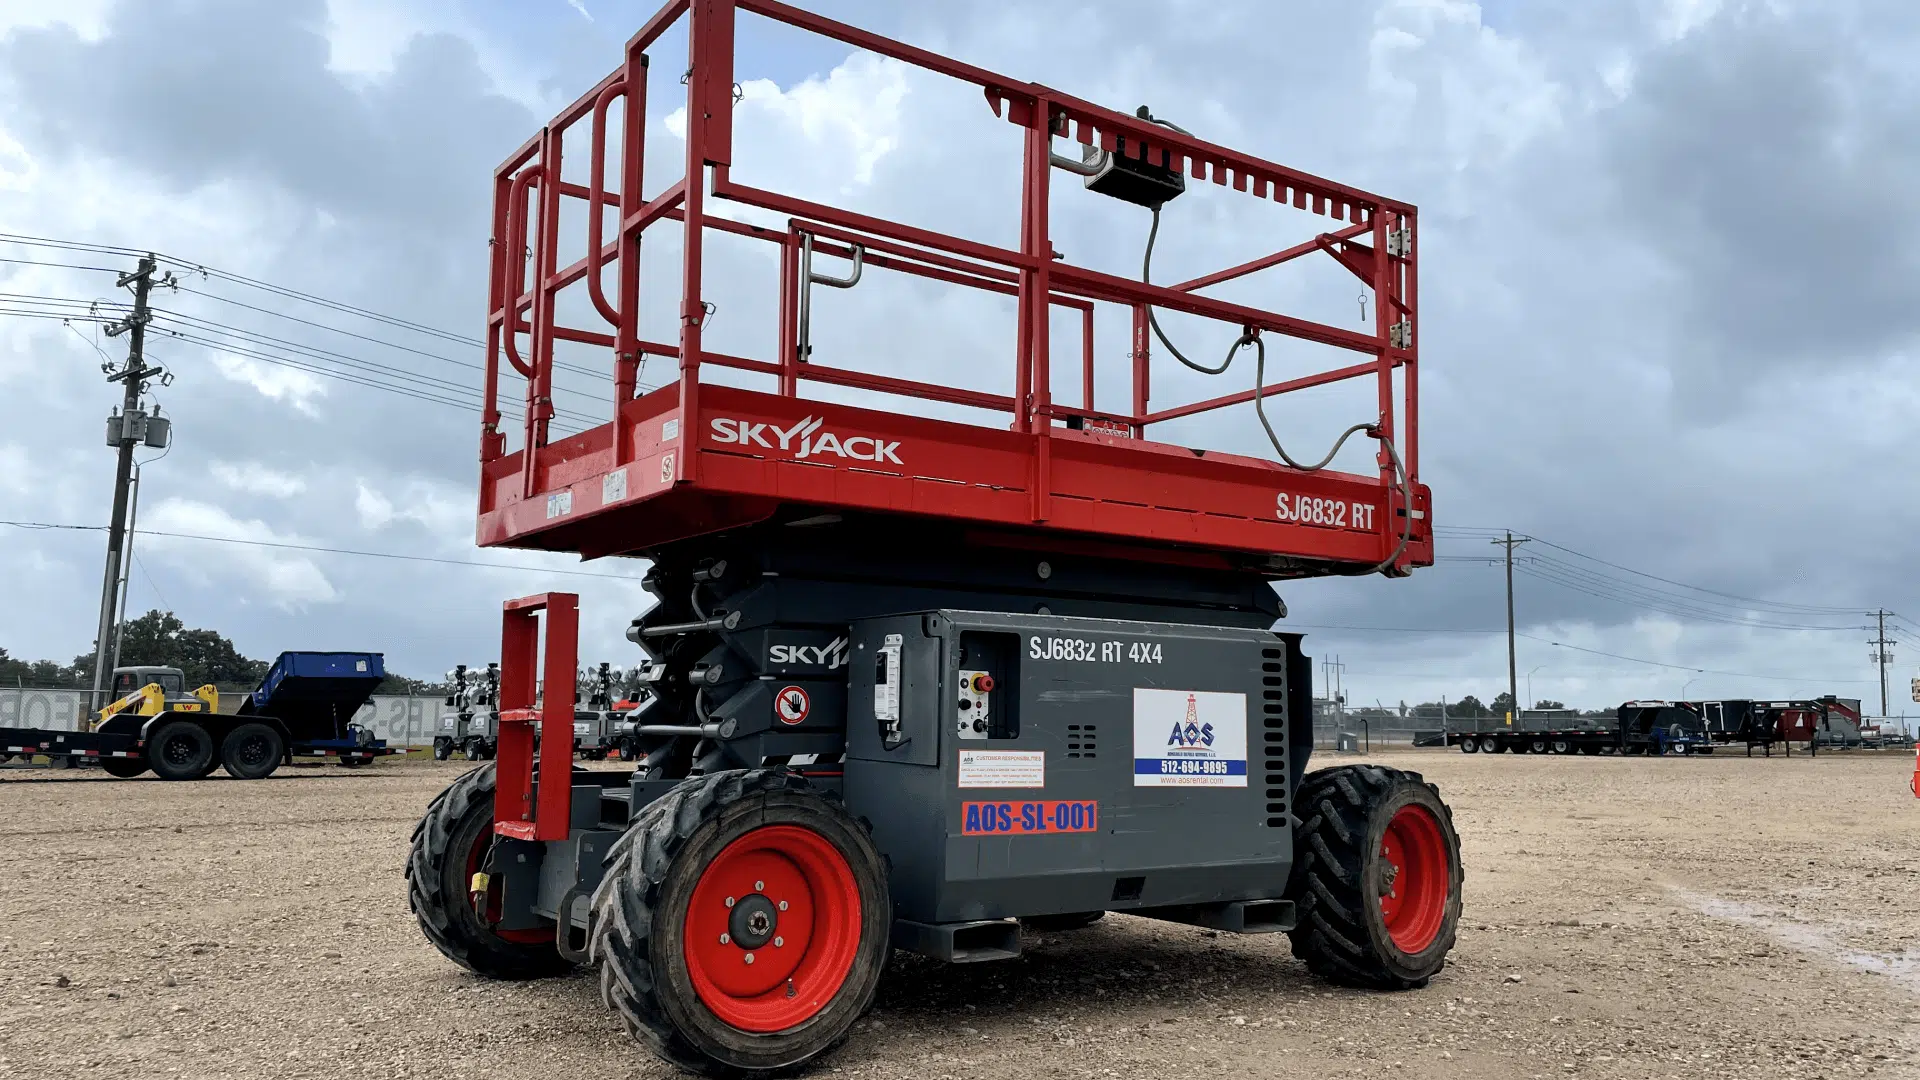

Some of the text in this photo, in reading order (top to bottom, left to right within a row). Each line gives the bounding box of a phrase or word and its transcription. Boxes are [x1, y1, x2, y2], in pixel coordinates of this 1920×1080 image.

[711, 414, 905, 466] SKYJACK
[1276, 492, 1375, 530] SJ6832 RT
[1029, 636, 1163, 664] SJ6832 RT 4X4
[1168, 721, 1215, 747] AOS
[1160, 777, 1224, 785] www.aosrental.com
[1161, 760, 1228, 774] 512-694-9895
[966, 803, 1095, 832] AOS-SL-001
